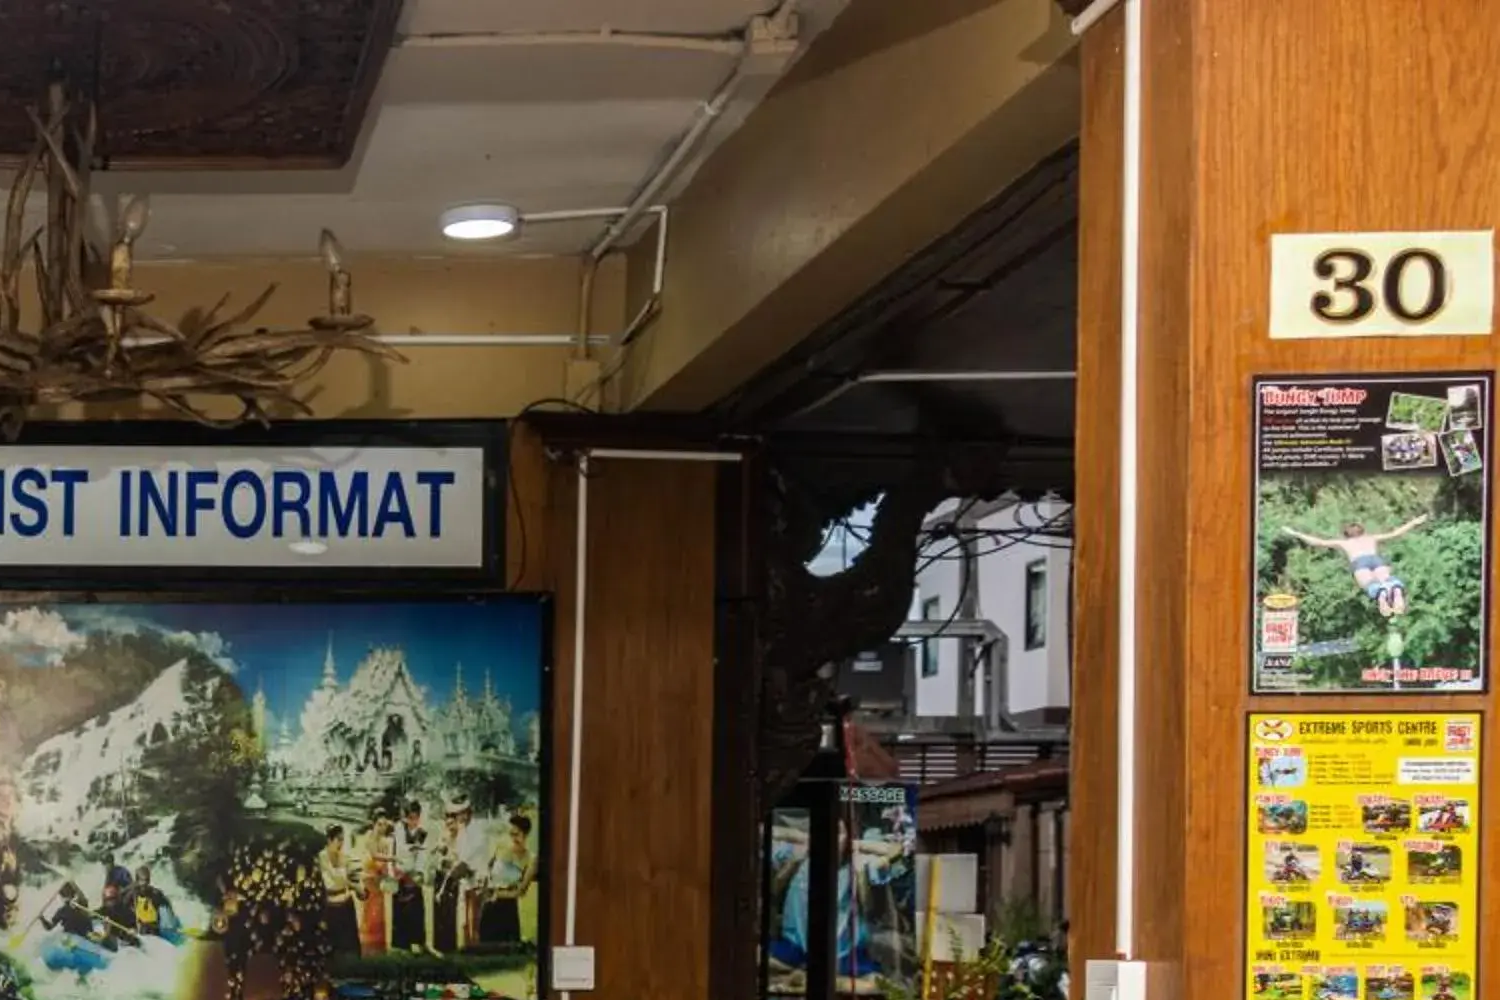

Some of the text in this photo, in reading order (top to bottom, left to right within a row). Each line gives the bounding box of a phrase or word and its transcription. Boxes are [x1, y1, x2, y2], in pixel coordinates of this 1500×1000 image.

[1311, 248, 1447, 322] 30
[120, 470, 456, 539] INFORMAT
[1299, 720, 1437, 735] EXTREME SPORTS CENTRE
